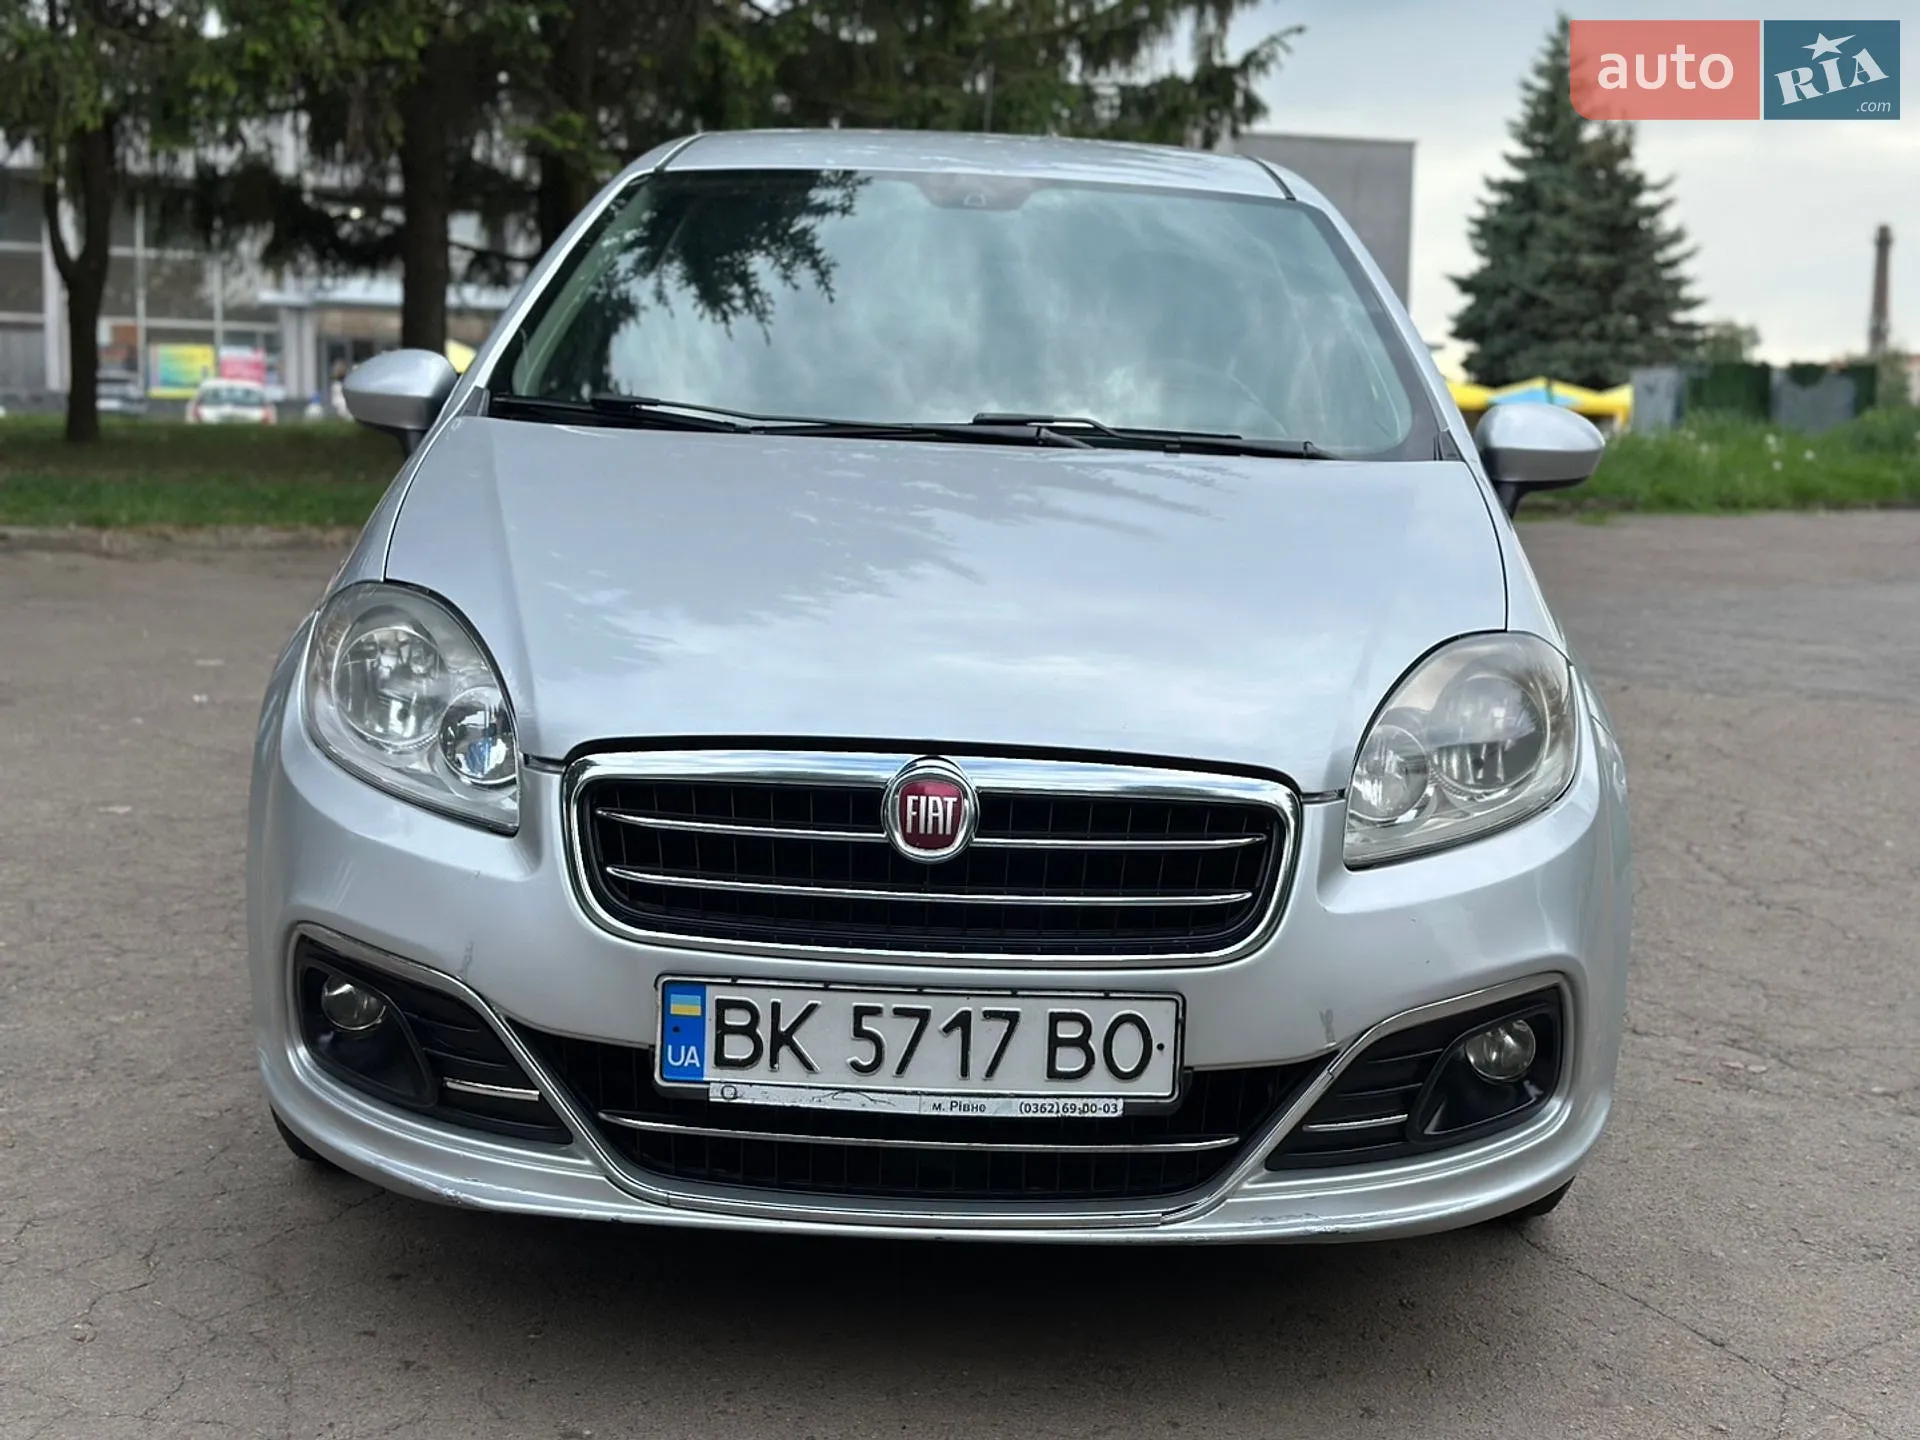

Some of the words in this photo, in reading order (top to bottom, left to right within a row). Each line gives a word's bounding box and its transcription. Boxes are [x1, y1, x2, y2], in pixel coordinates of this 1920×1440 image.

[906, 795, 957, 835] FIAT
[667, 1044, 701, 1069] UA
[713, 996, 821, 1074] BK
[846, 1003, 1021, 1081] 5717
[1046, 1010, 1154, 1082] BO
